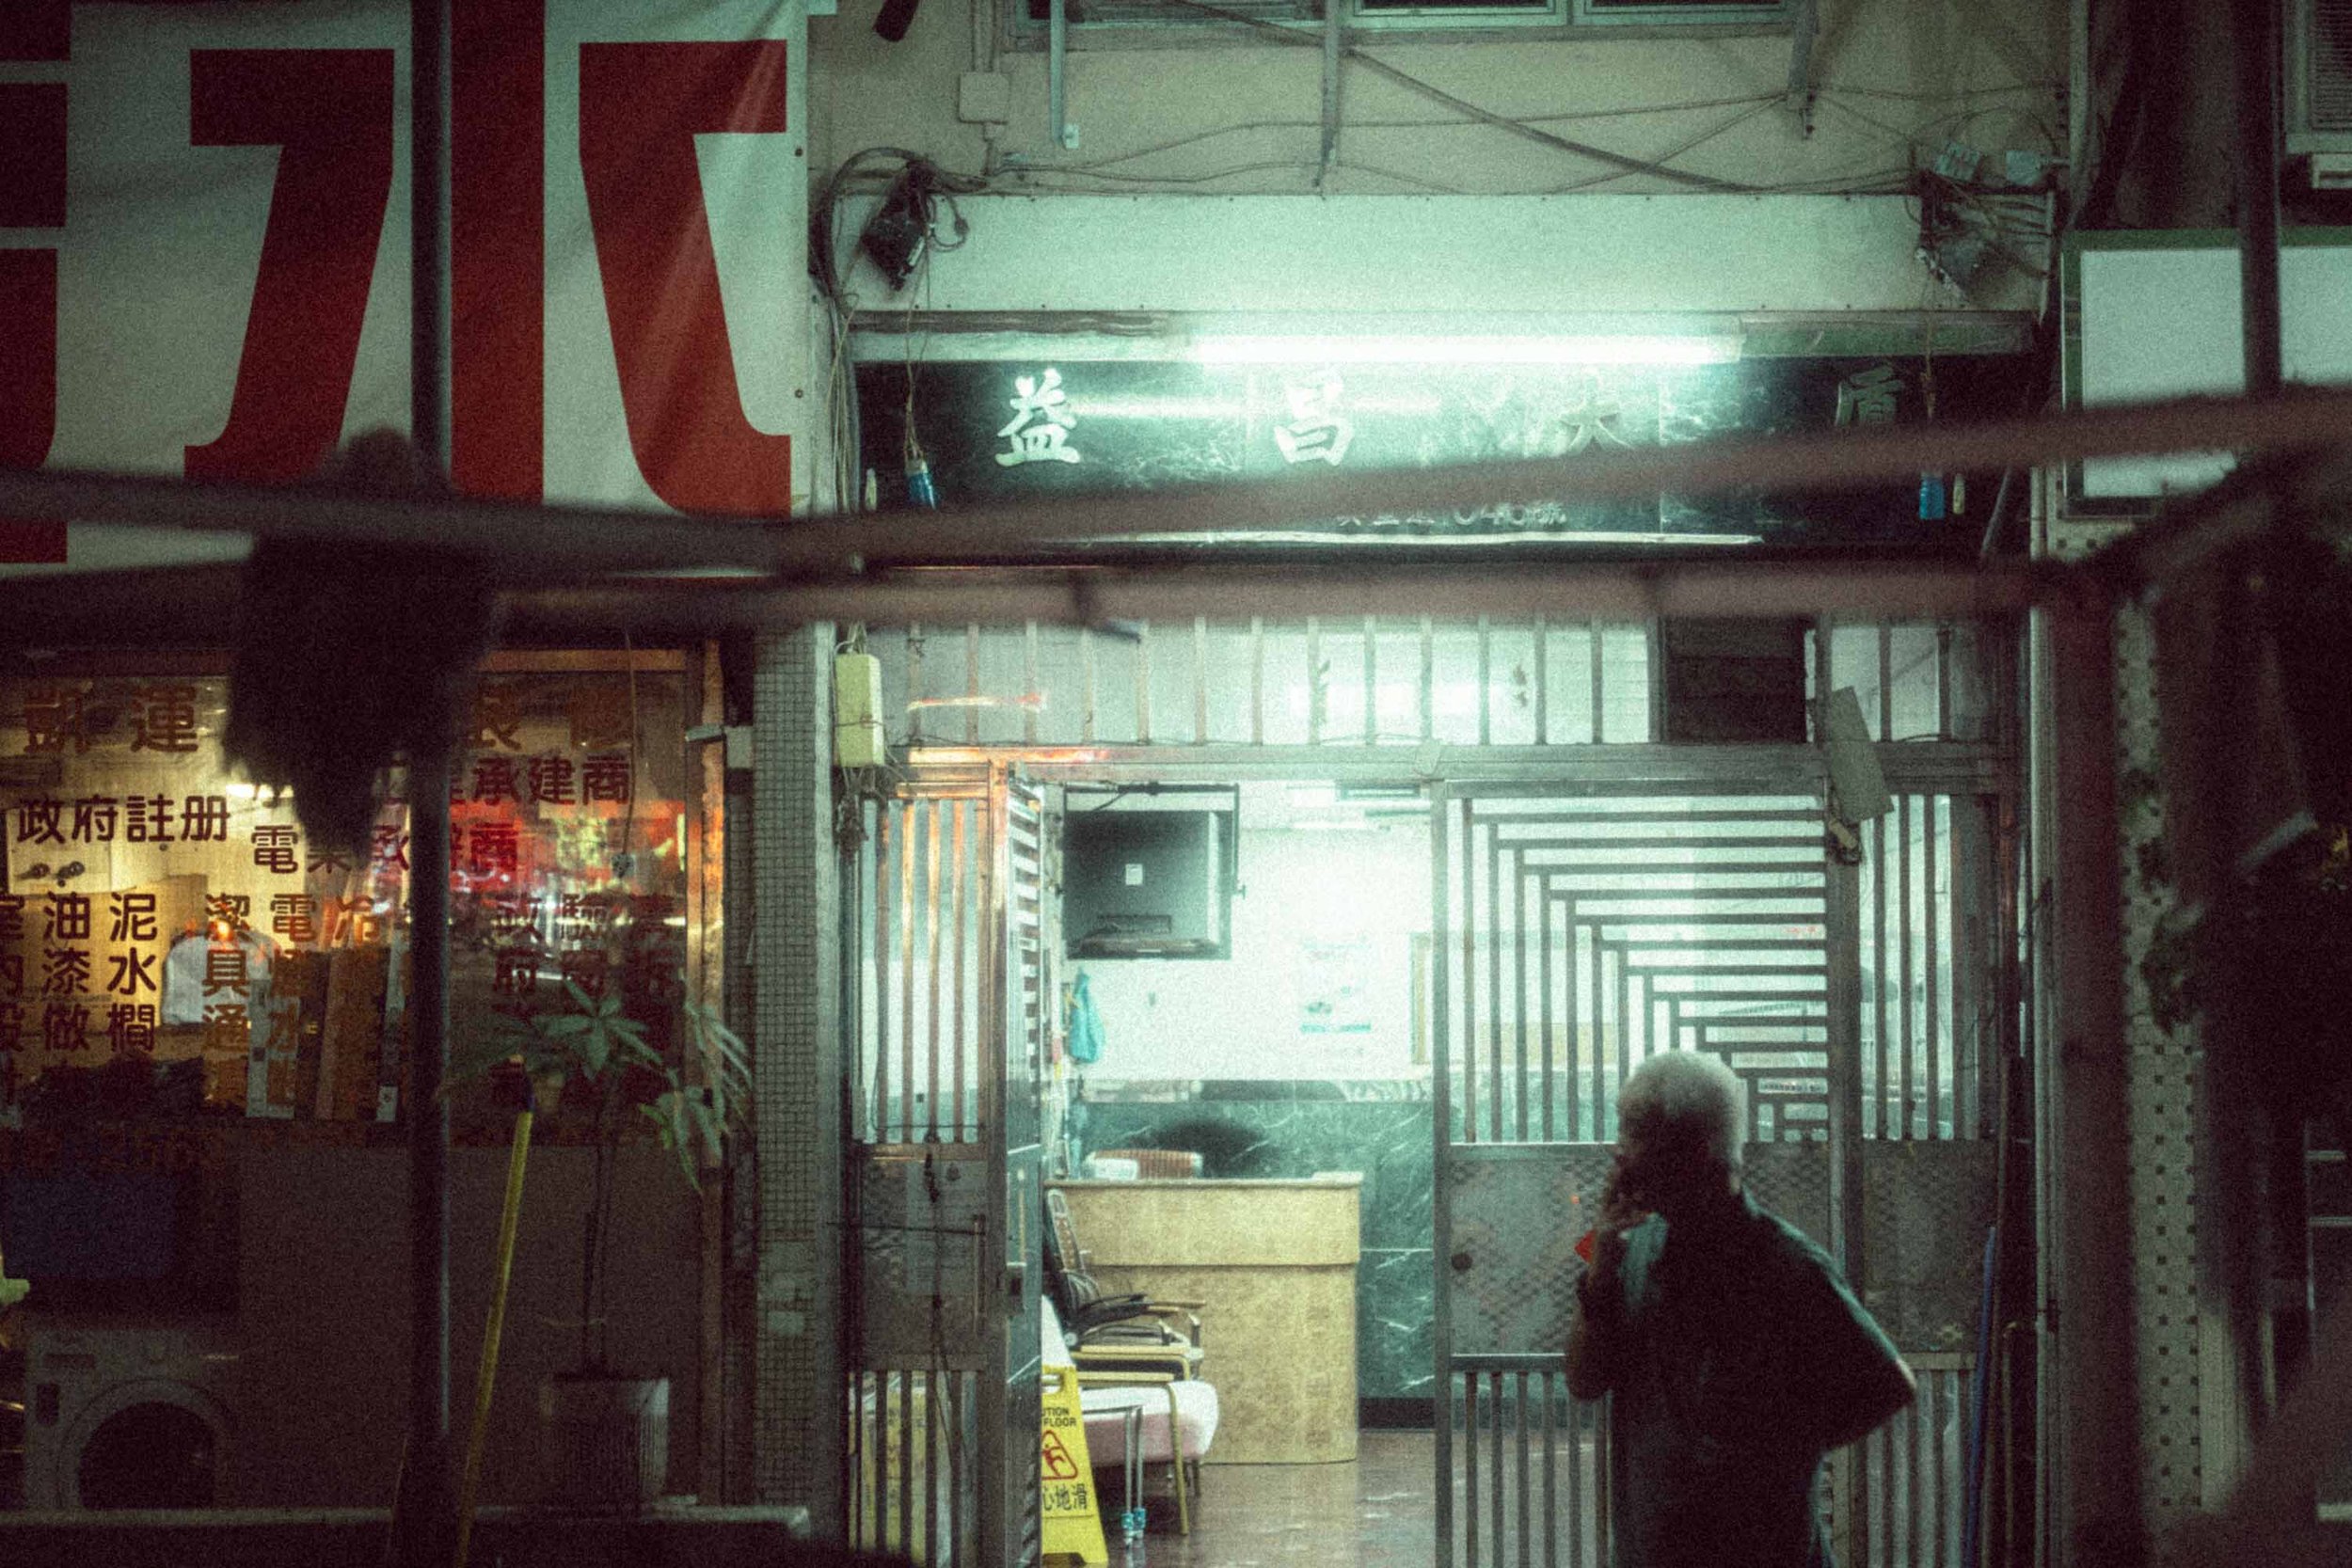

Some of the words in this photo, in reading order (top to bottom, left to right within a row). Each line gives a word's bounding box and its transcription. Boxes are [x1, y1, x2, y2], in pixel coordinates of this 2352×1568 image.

[450, 755, 630, 806] 承建商
[18, 795, 230, 844] 政府註册
[203, 893, 251, 1102] 潔具通
[1043, 1418, 1077, 1427] FLOOR
